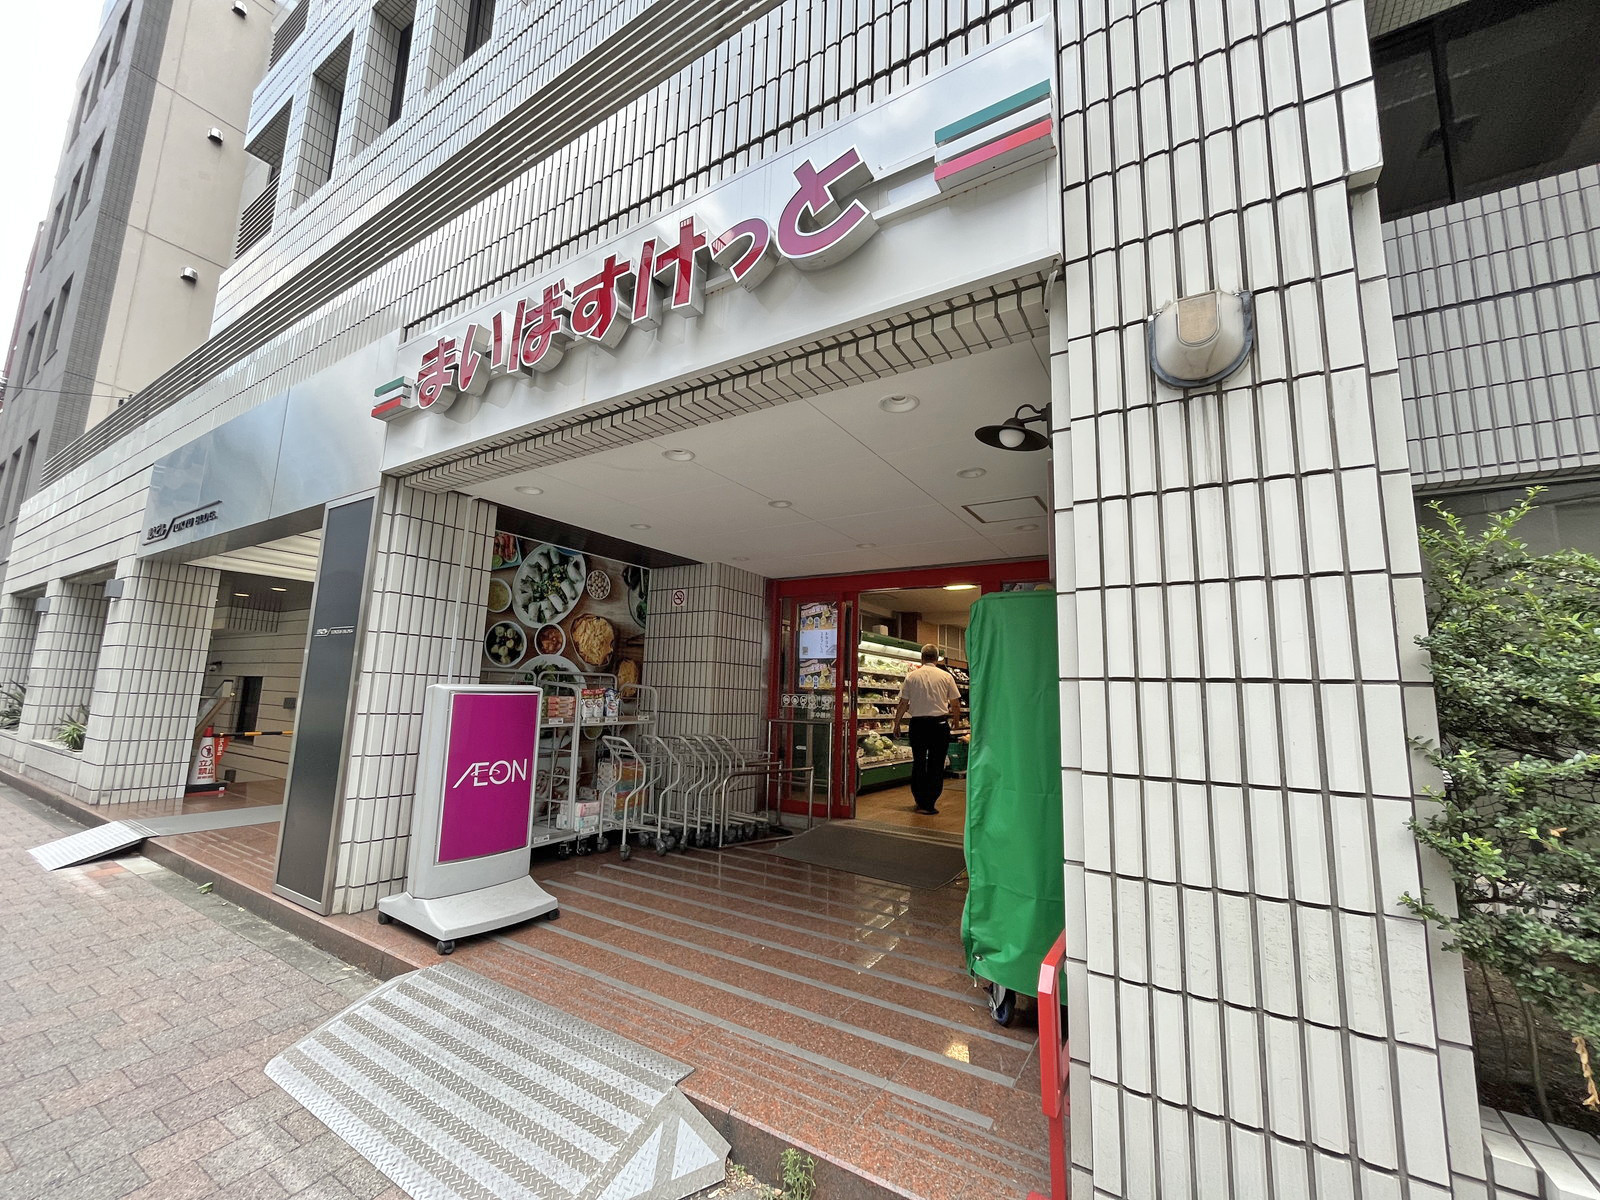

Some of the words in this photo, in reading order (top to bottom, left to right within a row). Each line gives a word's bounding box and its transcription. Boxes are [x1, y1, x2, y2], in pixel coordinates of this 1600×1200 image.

[416, 144, 872, 411] まいばすけっと
